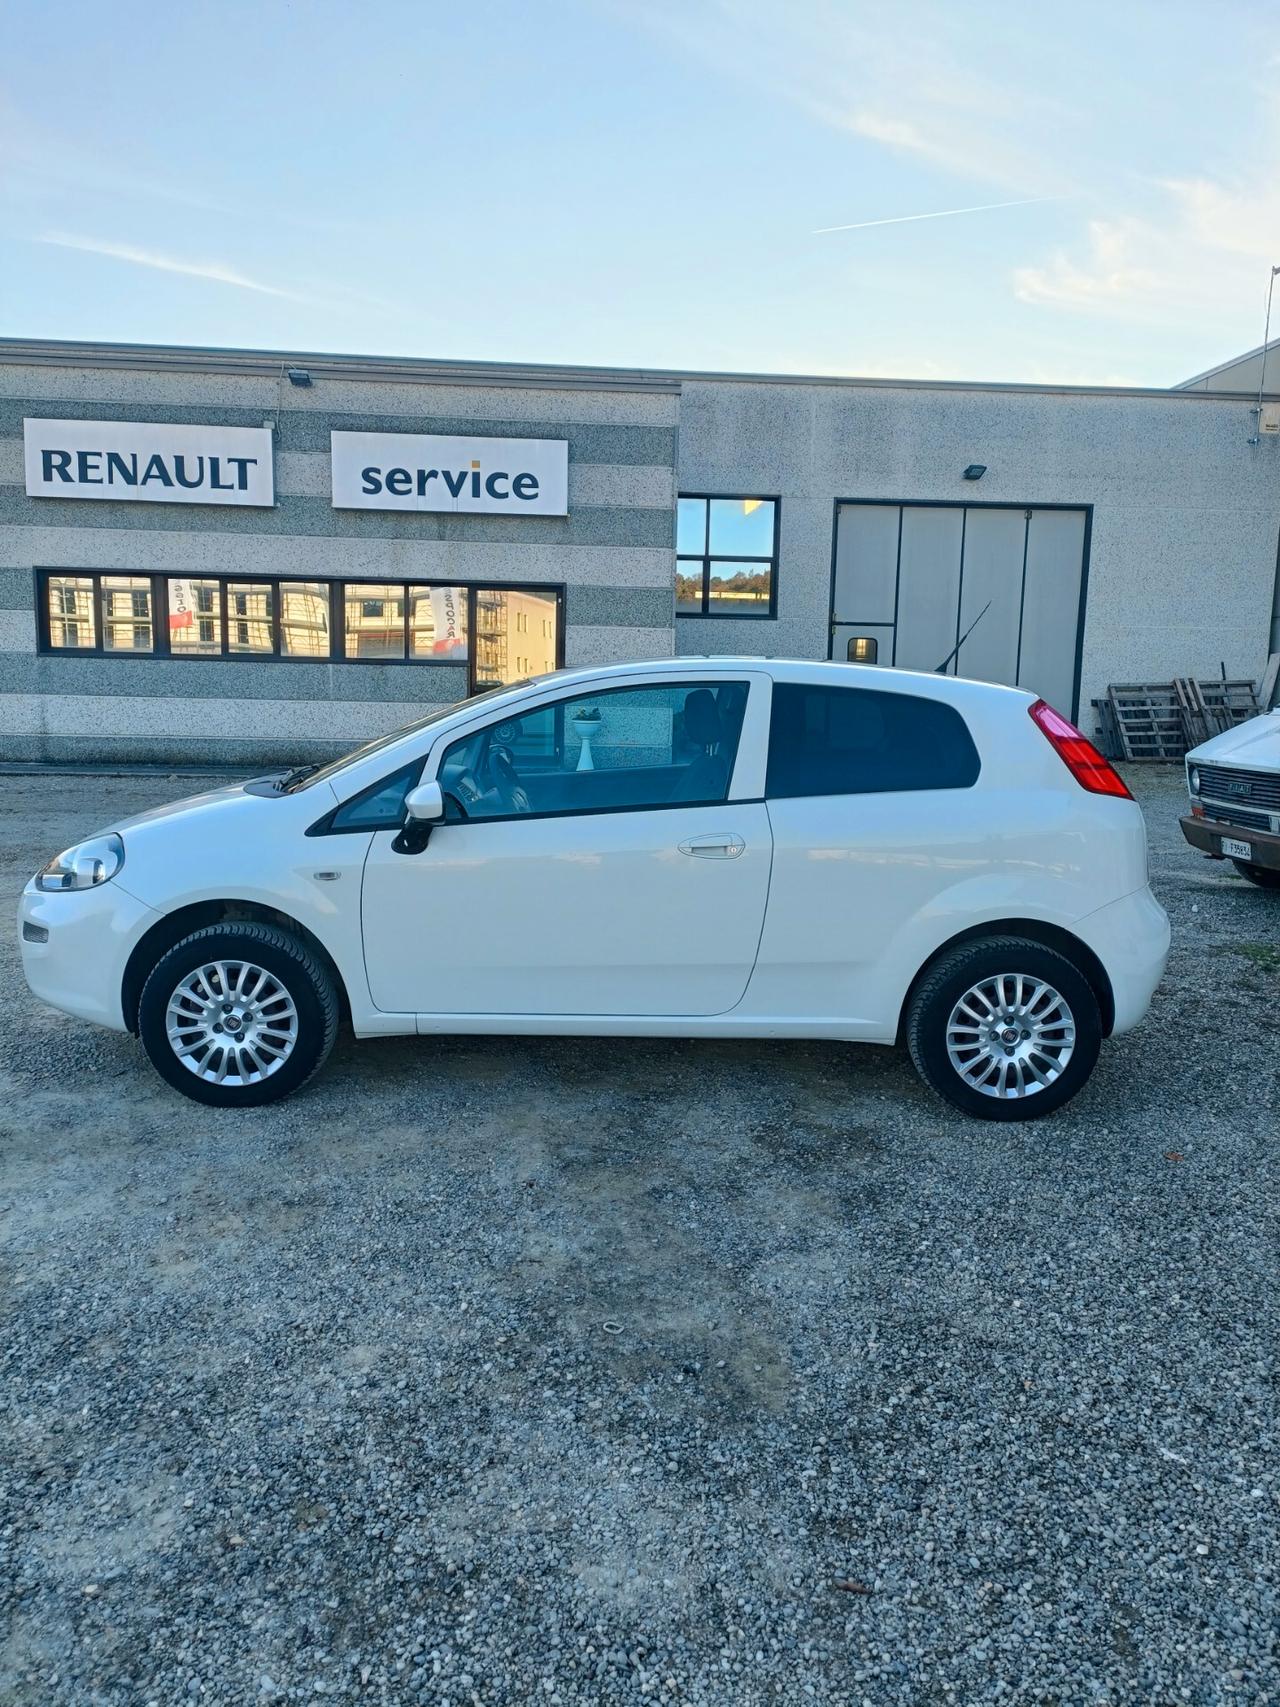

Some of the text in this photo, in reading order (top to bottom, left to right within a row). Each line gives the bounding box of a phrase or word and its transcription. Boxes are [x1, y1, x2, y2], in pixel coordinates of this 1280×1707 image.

[41, 449, 257, 490] RENAULT
[361, 460, 539, 500] service
[1228, 783, 1251, 795] FIAT
